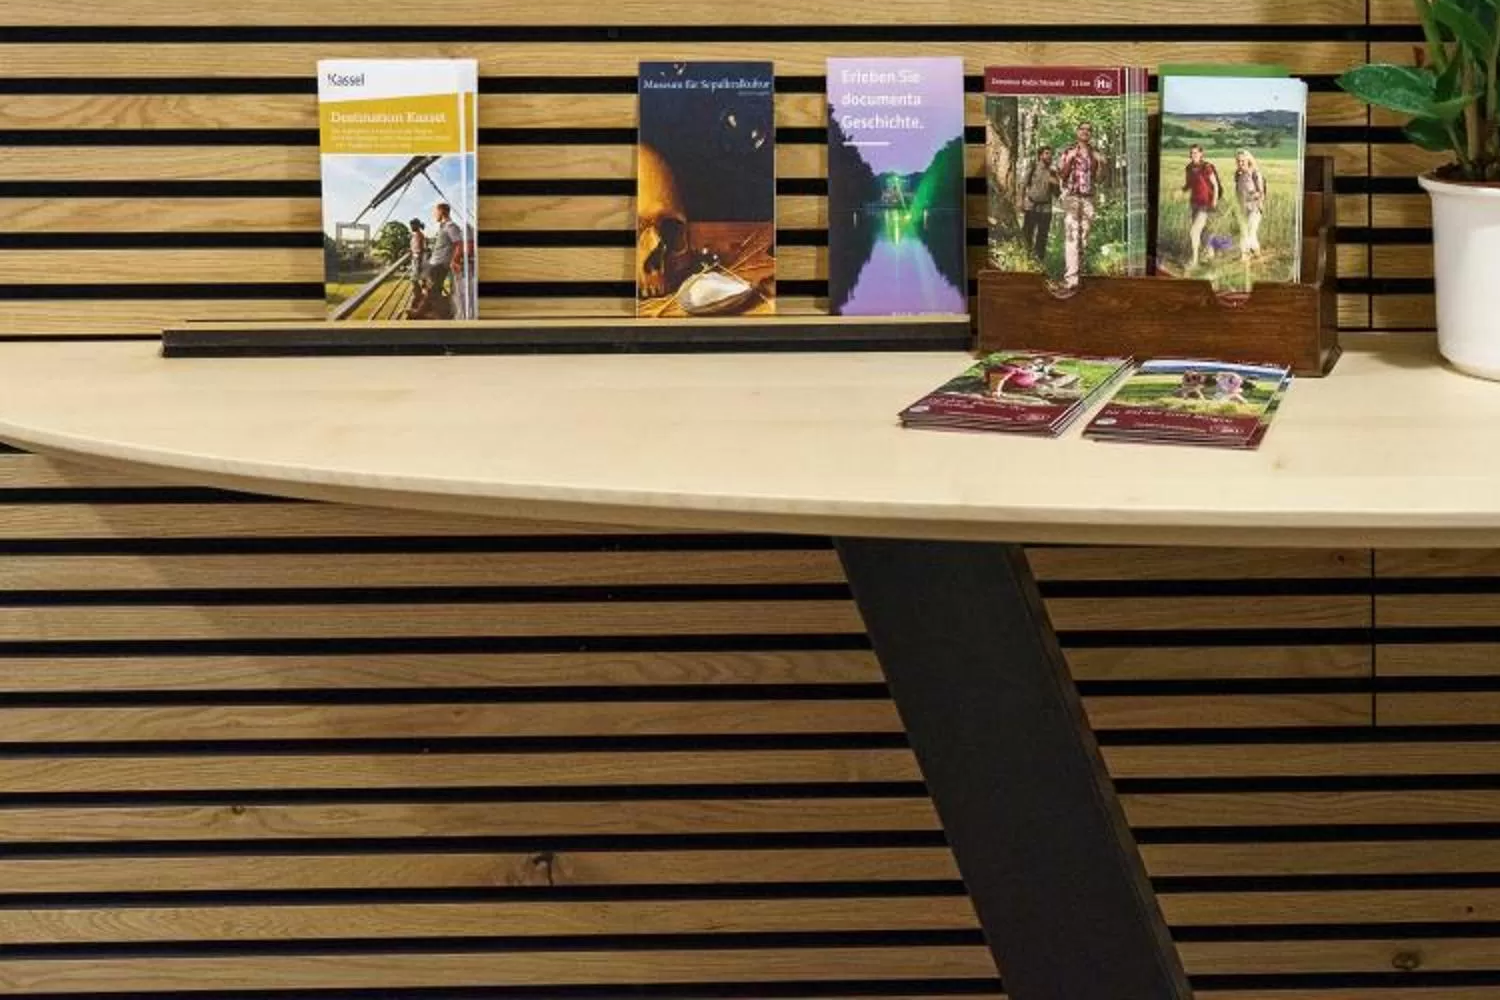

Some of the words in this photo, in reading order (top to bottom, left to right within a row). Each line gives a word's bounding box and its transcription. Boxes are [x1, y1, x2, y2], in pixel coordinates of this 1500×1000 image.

[327, 73, 365, 86] Kassel
[841, 70, 896, 84] Erleben
[899, 70, 921, 84] Sie
[643, 79, 683, 89] Museum
[841, 93, 922, 106] documenta
[841, 114, 925, 129] Geschichte.
